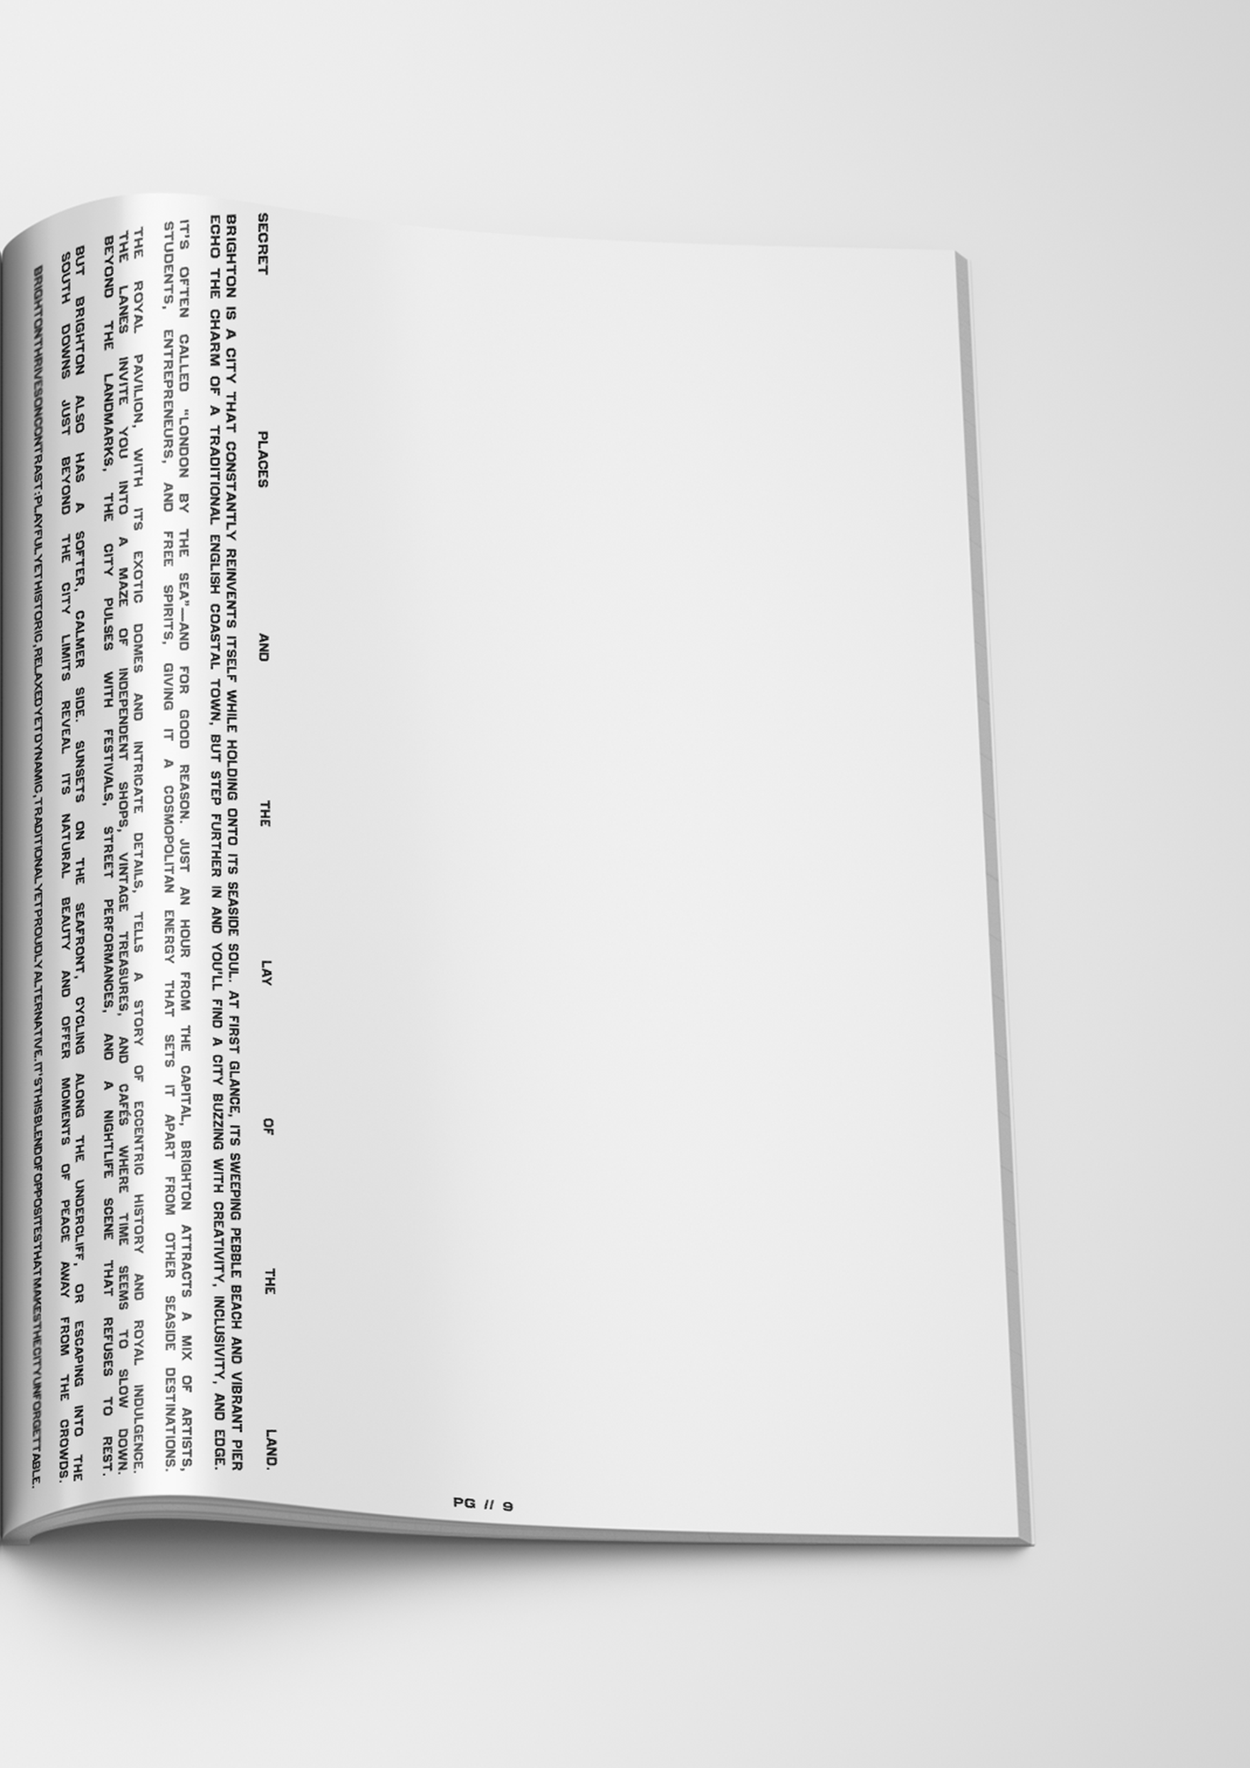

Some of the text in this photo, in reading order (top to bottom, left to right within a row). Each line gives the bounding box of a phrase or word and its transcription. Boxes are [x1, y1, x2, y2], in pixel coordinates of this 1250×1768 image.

[59, 251, 71, 1483] SOUTH DOWNS JUST BEYOND THE CITY LIMITS REVEAL ITS NATURAL BEAUTY AND OFFER MOMENTS OF PEACE AWAY FROM THE CROWDS.
[102, 235, 114, 1476] BEYOND THE LANDMARKS, THE CITY PULSES WITH FESTIVALS, STREET PERFORMANCES, AND A NIGHTLIFE SCENE THAT REFUSES TO REST.
[132, 226, 145, 1473] THE ROYAL PAVILION, WITH ITS EXOTIC DOMES AND INTRICATE DETAILS, TELLS A STORY OF ECCENTRIC HISTORY AND ROYAL INDULGENCE.
[161, 221, 176, 1472] STUDENTS, ENTREPRENEURS, AND FREE SPIRITS, GIVING IT A COSMOPOLITAN ENERGY THAT SETS IT APART FROM OTHER SEASIDE DESTINATIONS.
[226, 214, 243, 1471] BRIGHTON IS A CITY THAT CONSTANTLY REINVENTS ITSELF WHILE HOLDING ONTO ITS SEASIDE SOUL. AT FIRST GLANCE, ITS SWEEPING PEBBLE BEACH AND VIBRANT PIER
[258, 213, 278, 1470] SECRET PLACES AND THE LAY OF THE LAND.
[453, 1497, 476, 1509] PG
[502, 1501, 514, 1512] 9
